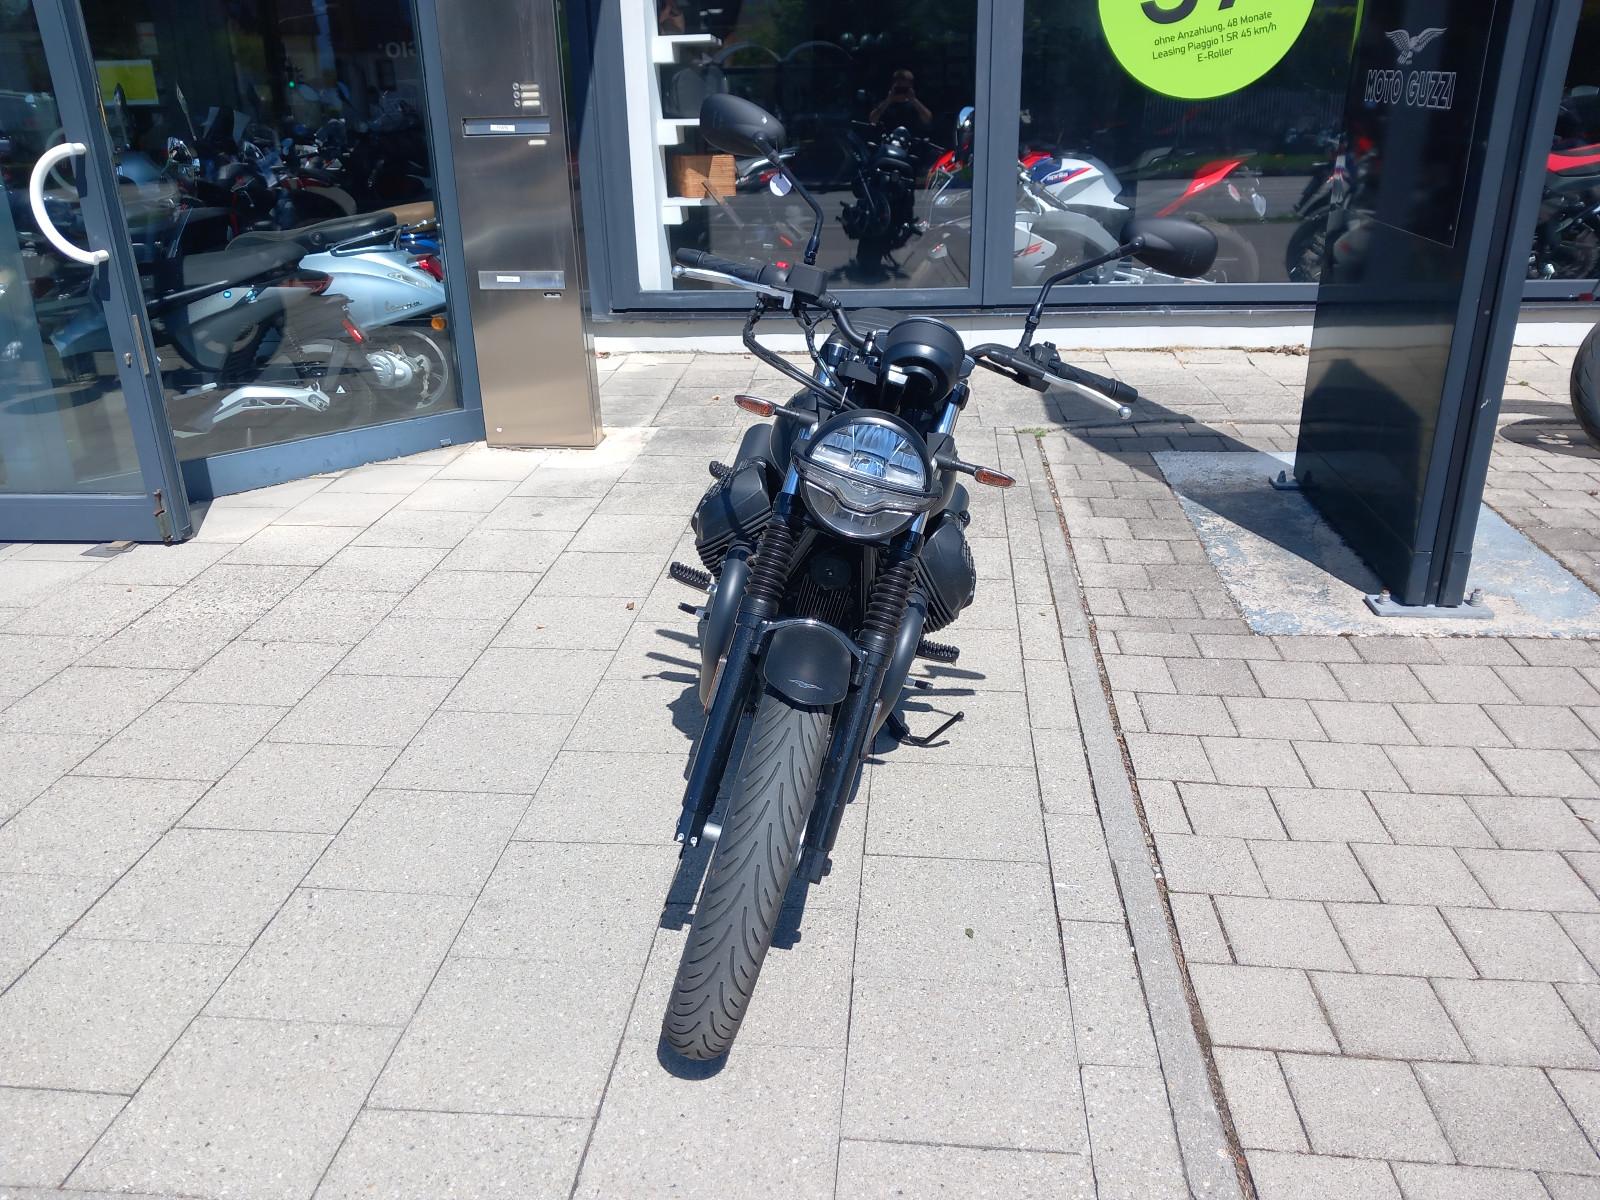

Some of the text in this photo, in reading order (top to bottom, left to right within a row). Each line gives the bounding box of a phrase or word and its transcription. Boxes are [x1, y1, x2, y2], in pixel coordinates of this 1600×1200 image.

[1152, 45, 1186, 60] Leasing
[1187, 37, 1219, 52] Piaggio
[1226, 31, 1239, 42] SR
[1241, 27, 1252, 38] 45
[1253, 22, 1277, 36] km/h
[1154, 35, 1176, 46] ohne
[1227, 17, 1238, 28] 48
[1240, 11, 1273, 25] Monate
[1197, 47, 1234, 62] E-Roller
[1364, 69, 1457, 110] MOTO GUZZI
